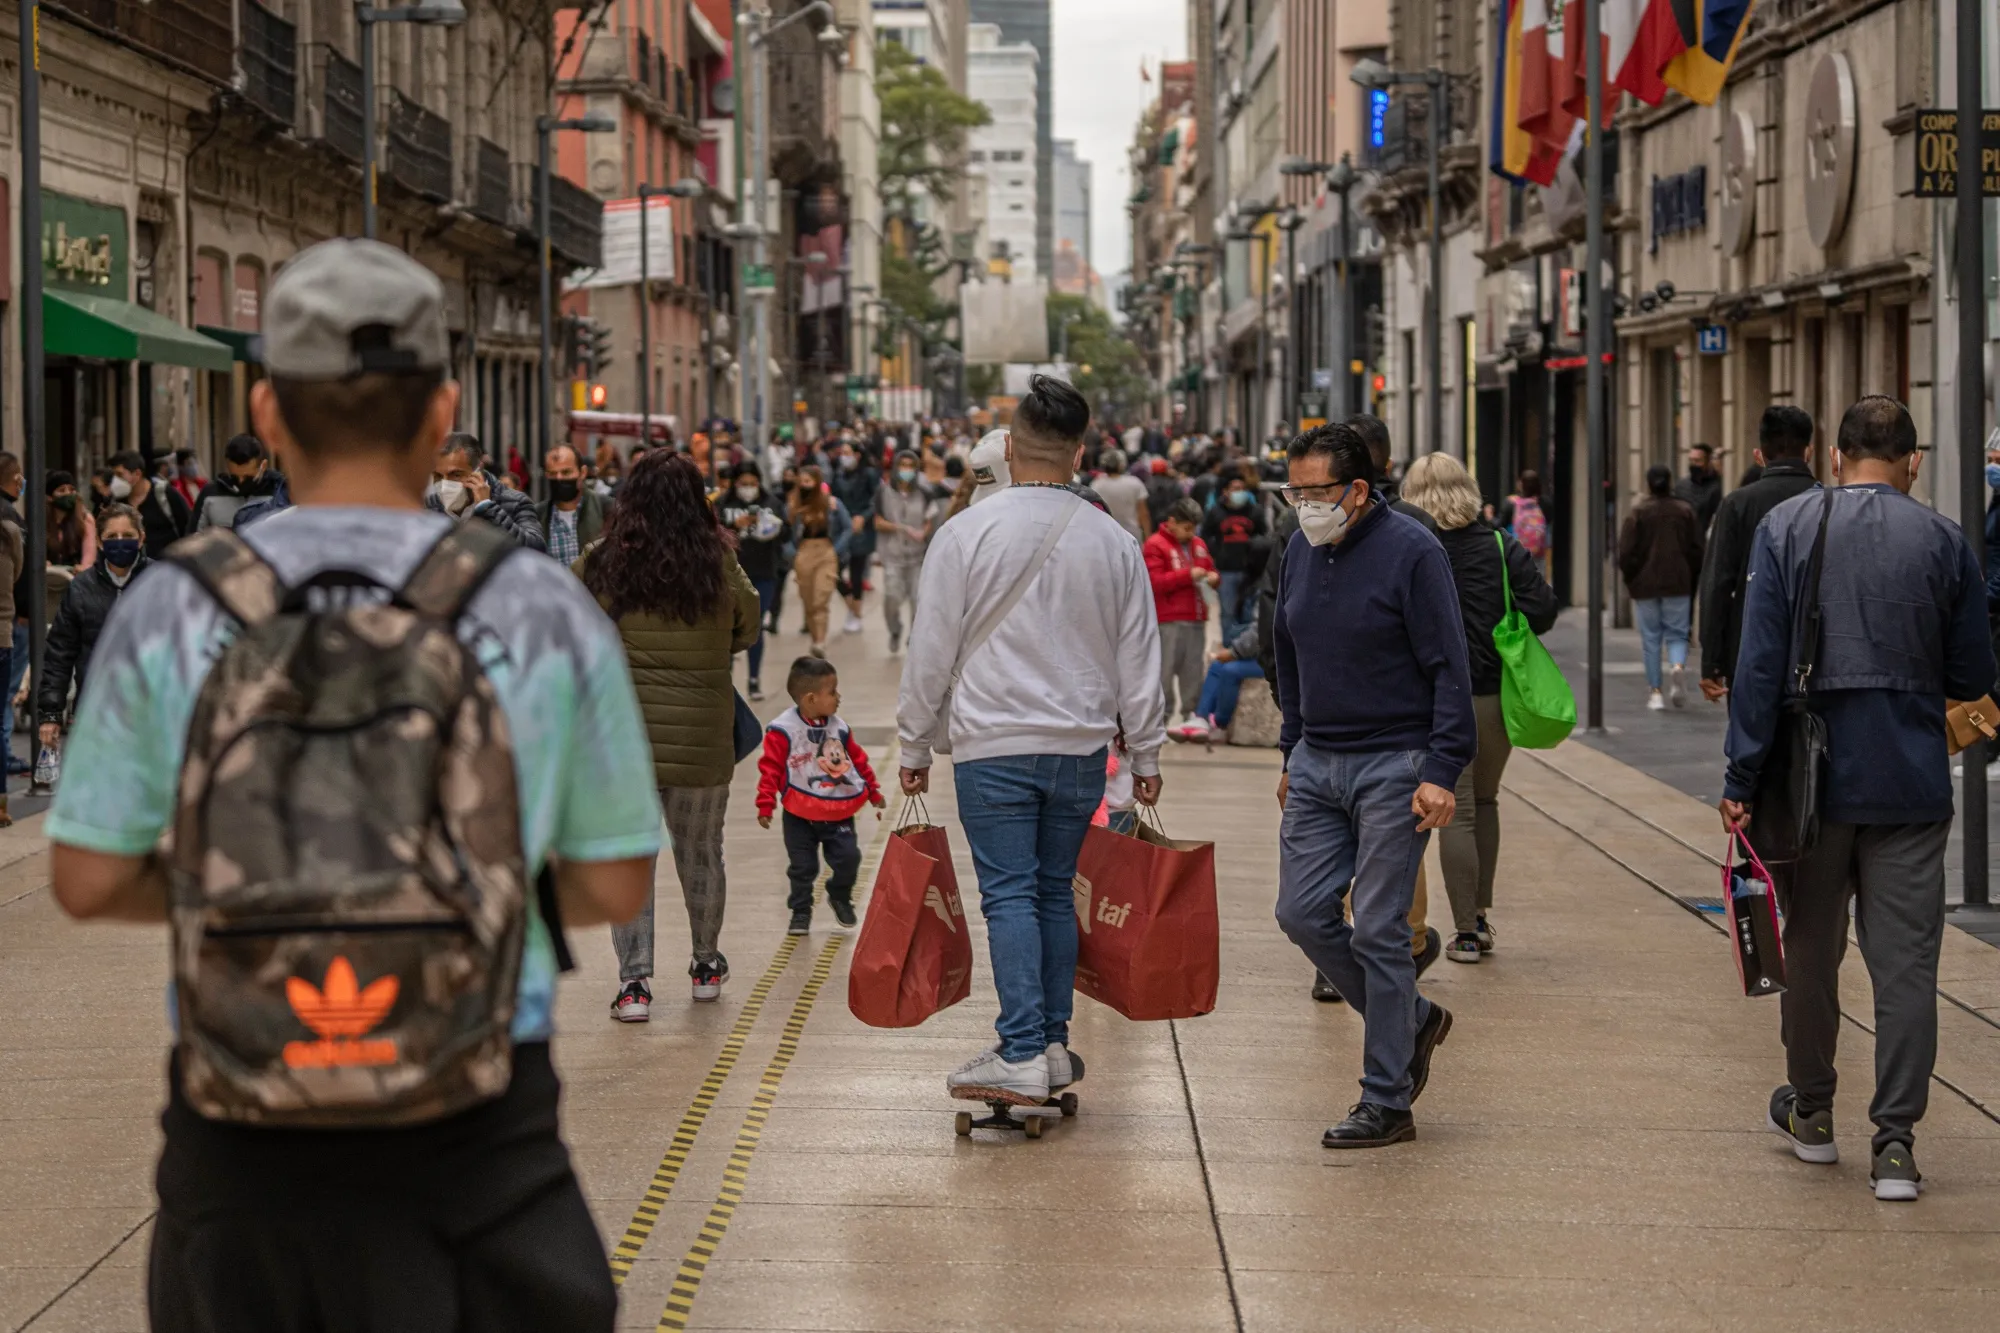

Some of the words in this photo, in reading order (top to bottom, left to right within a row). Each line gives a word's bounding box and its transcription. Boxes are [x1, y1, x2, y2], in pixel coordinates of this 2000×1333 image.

[1921, 114, 1957, 130] COMP
[1920, 132, 1958, 172] OR
[1704, 329, 1722, 349] H
[1096, 896, 1132, 929] taf
